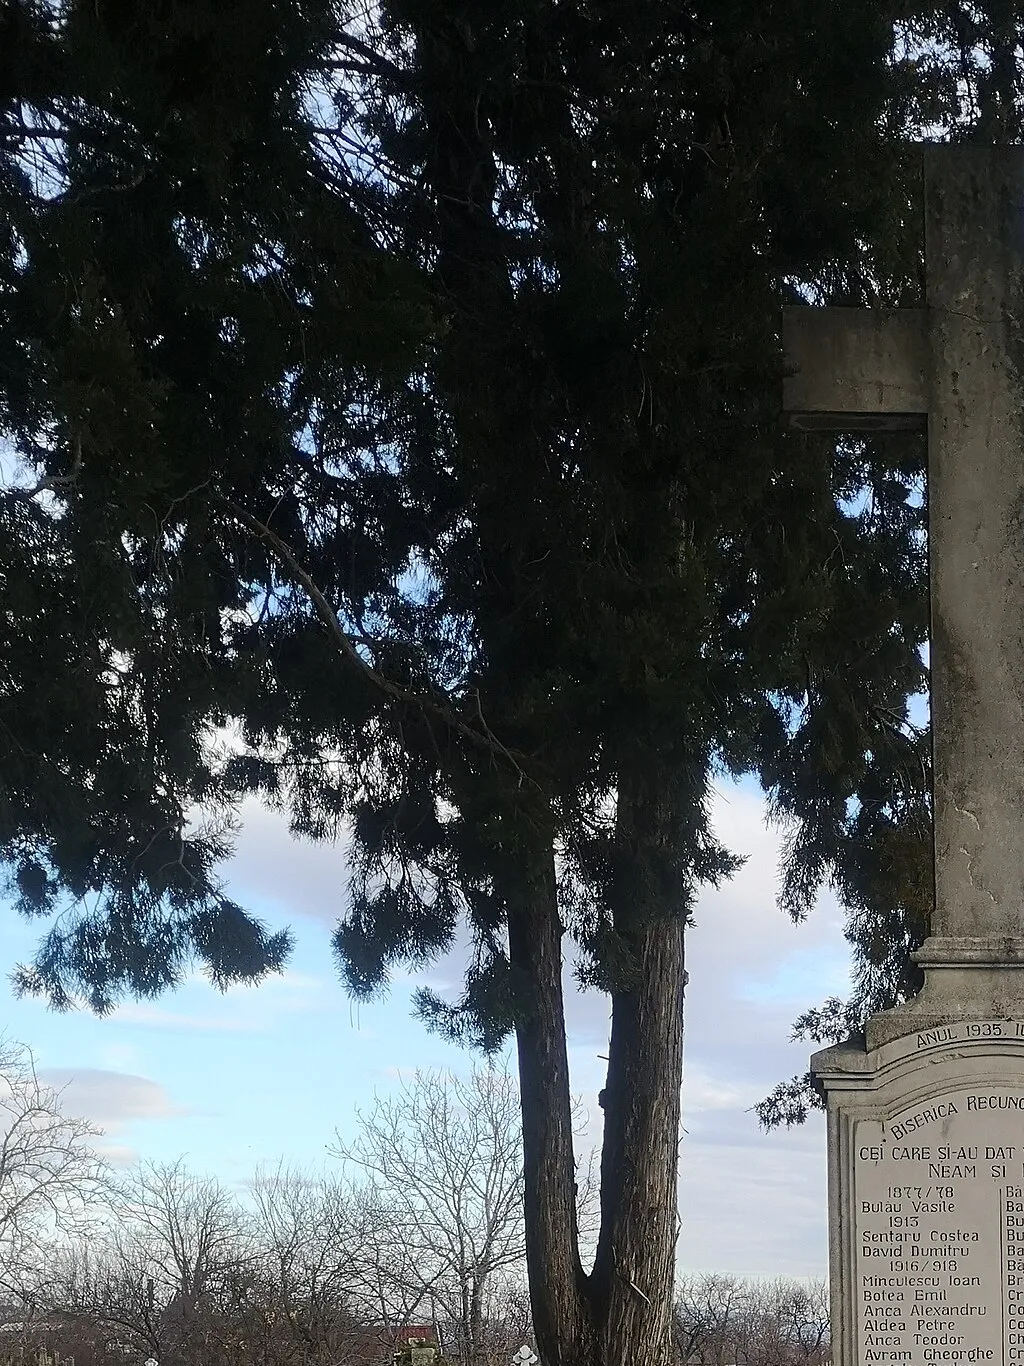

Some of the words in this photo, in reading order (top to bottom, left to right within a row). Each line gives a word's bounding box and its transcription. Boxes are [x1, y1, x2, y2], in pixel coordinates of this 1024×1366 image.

[916, 1028, 958, 1048] ANUL
[965, 1023, 1007, 1037] 1935.
[891, 1147, 931, 1161] CARE
[985, 1146, 1016, 1160] DAT
[928, 1163, 977, 1178] NEAM
[911, 1201, 956, 1213] Vasile
[888, 1216, 919, 1228] 1913
[930, 1229, 980, 1242] Costea
[862, 1245, 903, 1257] David
[911, 1245, 970, 1257] Dumitru
[862, 1275, 940, 1287] Minculescu
[949, 1275, 981, 1287] Ioan
[863, 1290, 905, 1302] Botea
[914, 1289, 948, 1301] Emil
[863, 1304, 902, 1317] Anca
[910, 1303, 987, 1316] Alexandru
[864, 1319, 906, 1332] Aldea
[917, 1319, 956, 1331] Petre
[864, 1333, 901, 1346] Anca
[912, 1333, 965, 1345] Teodor
[864, 1348, 912, 1361] Avram
[923, 1347, 994, 1363] Gheorghe
